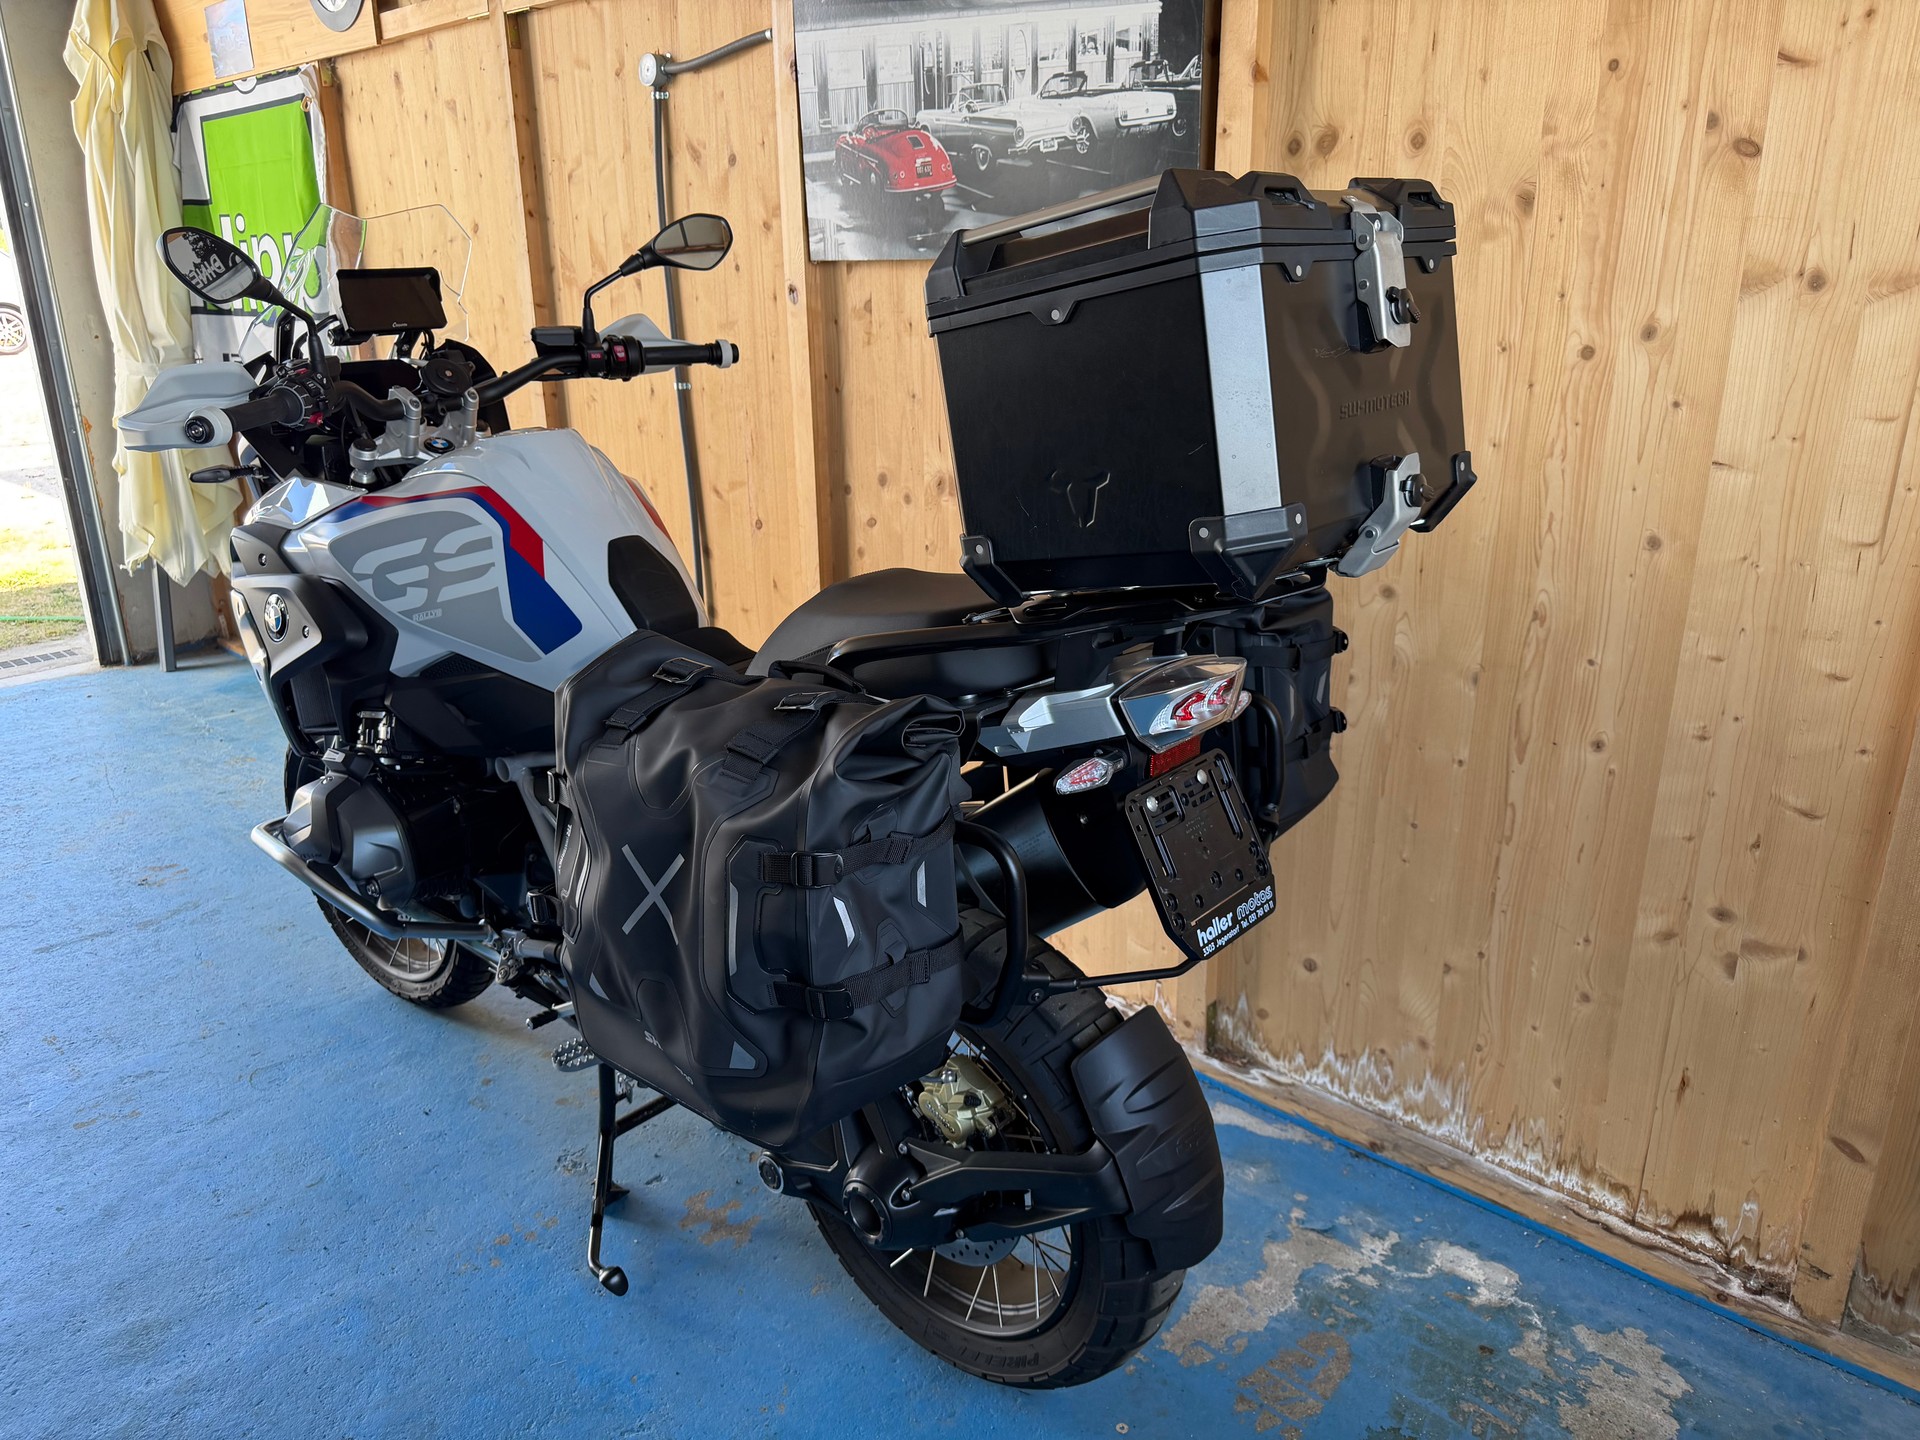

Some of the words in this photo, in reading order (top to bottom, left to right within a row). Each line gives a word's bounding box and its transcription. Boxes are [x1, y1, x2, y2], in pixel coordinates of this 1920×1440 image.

[1340, 390, 1411, 420] SW-MOTECH
[1196, 911, 1233, 947] haller
[1236, 885, 1273, 920] motos
[1202, 942, 1216, 957] 3303
